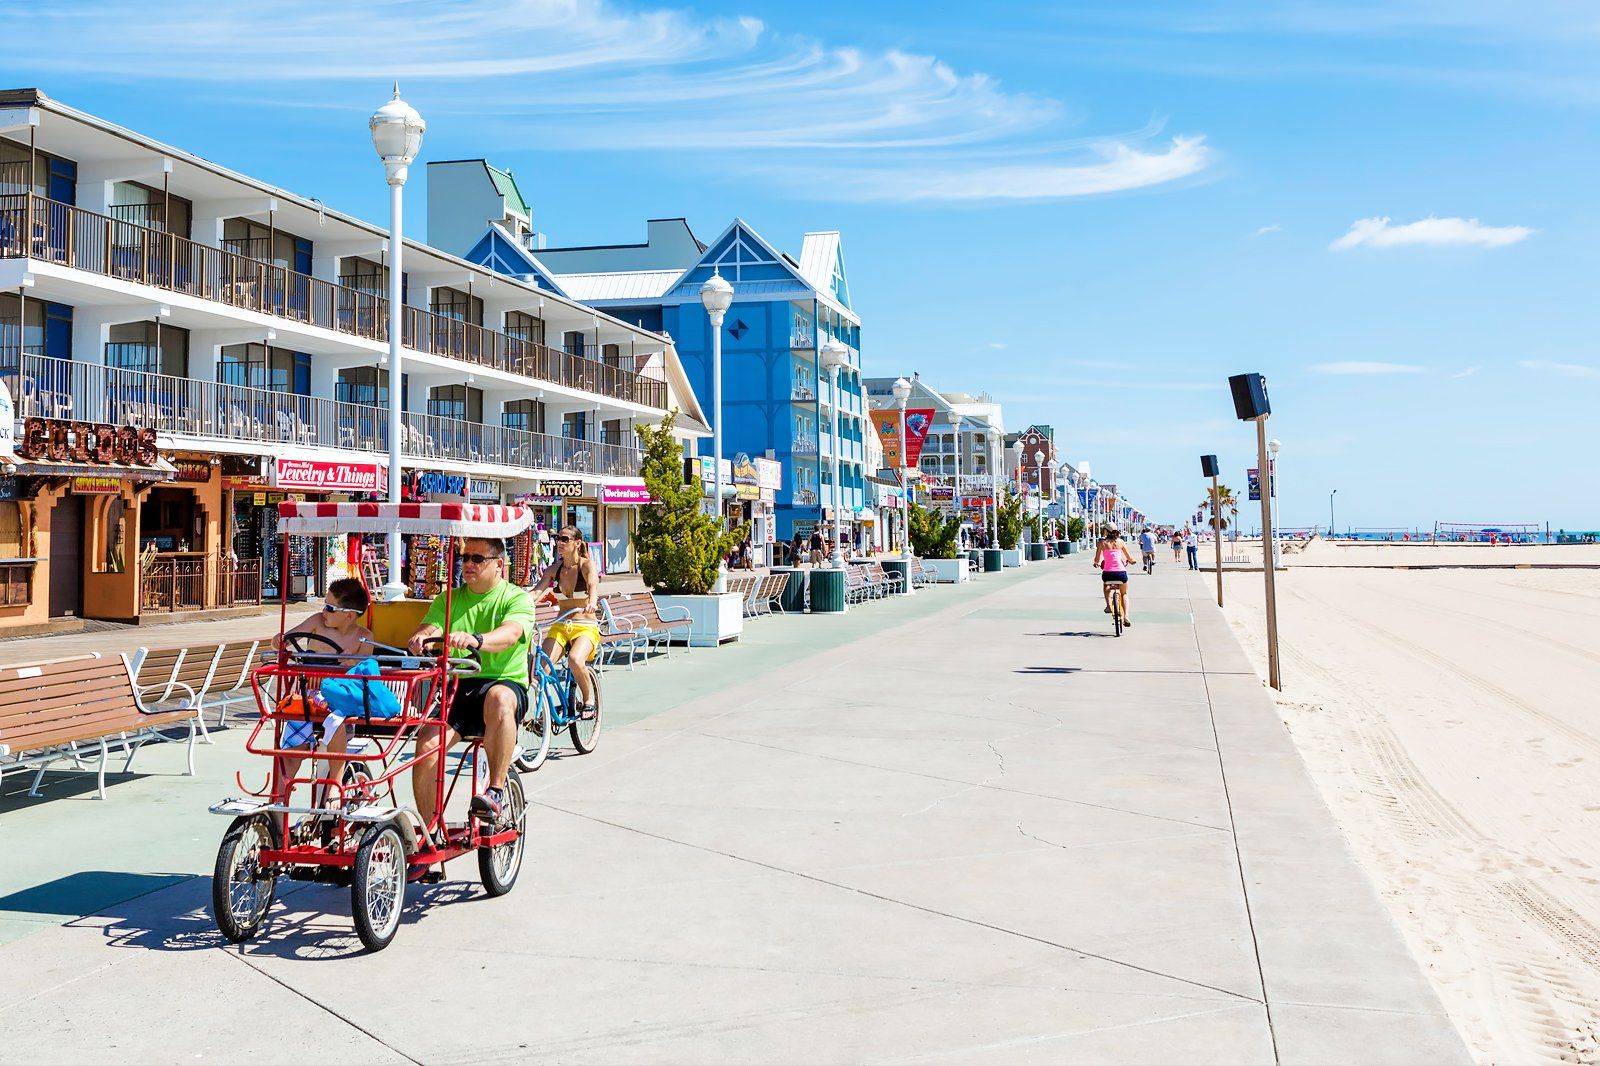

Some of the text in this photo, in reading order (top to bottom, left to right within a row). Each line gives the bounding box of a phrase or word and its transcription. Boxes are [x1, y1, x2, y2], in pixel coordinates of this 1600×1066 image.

[24, 417, 158, 466] GUIDOS
[277, 462, 326, 486] Jewelry
[327, 467, 335, 481] &
[336, 465, 376, 488] Things
[420, 473, 465, 495] FASHION SHOP
[477, 481, 488, 494] CITY
[489, 482, 493, 494] 2
[539, 485, 582, 496] ATTOOS
